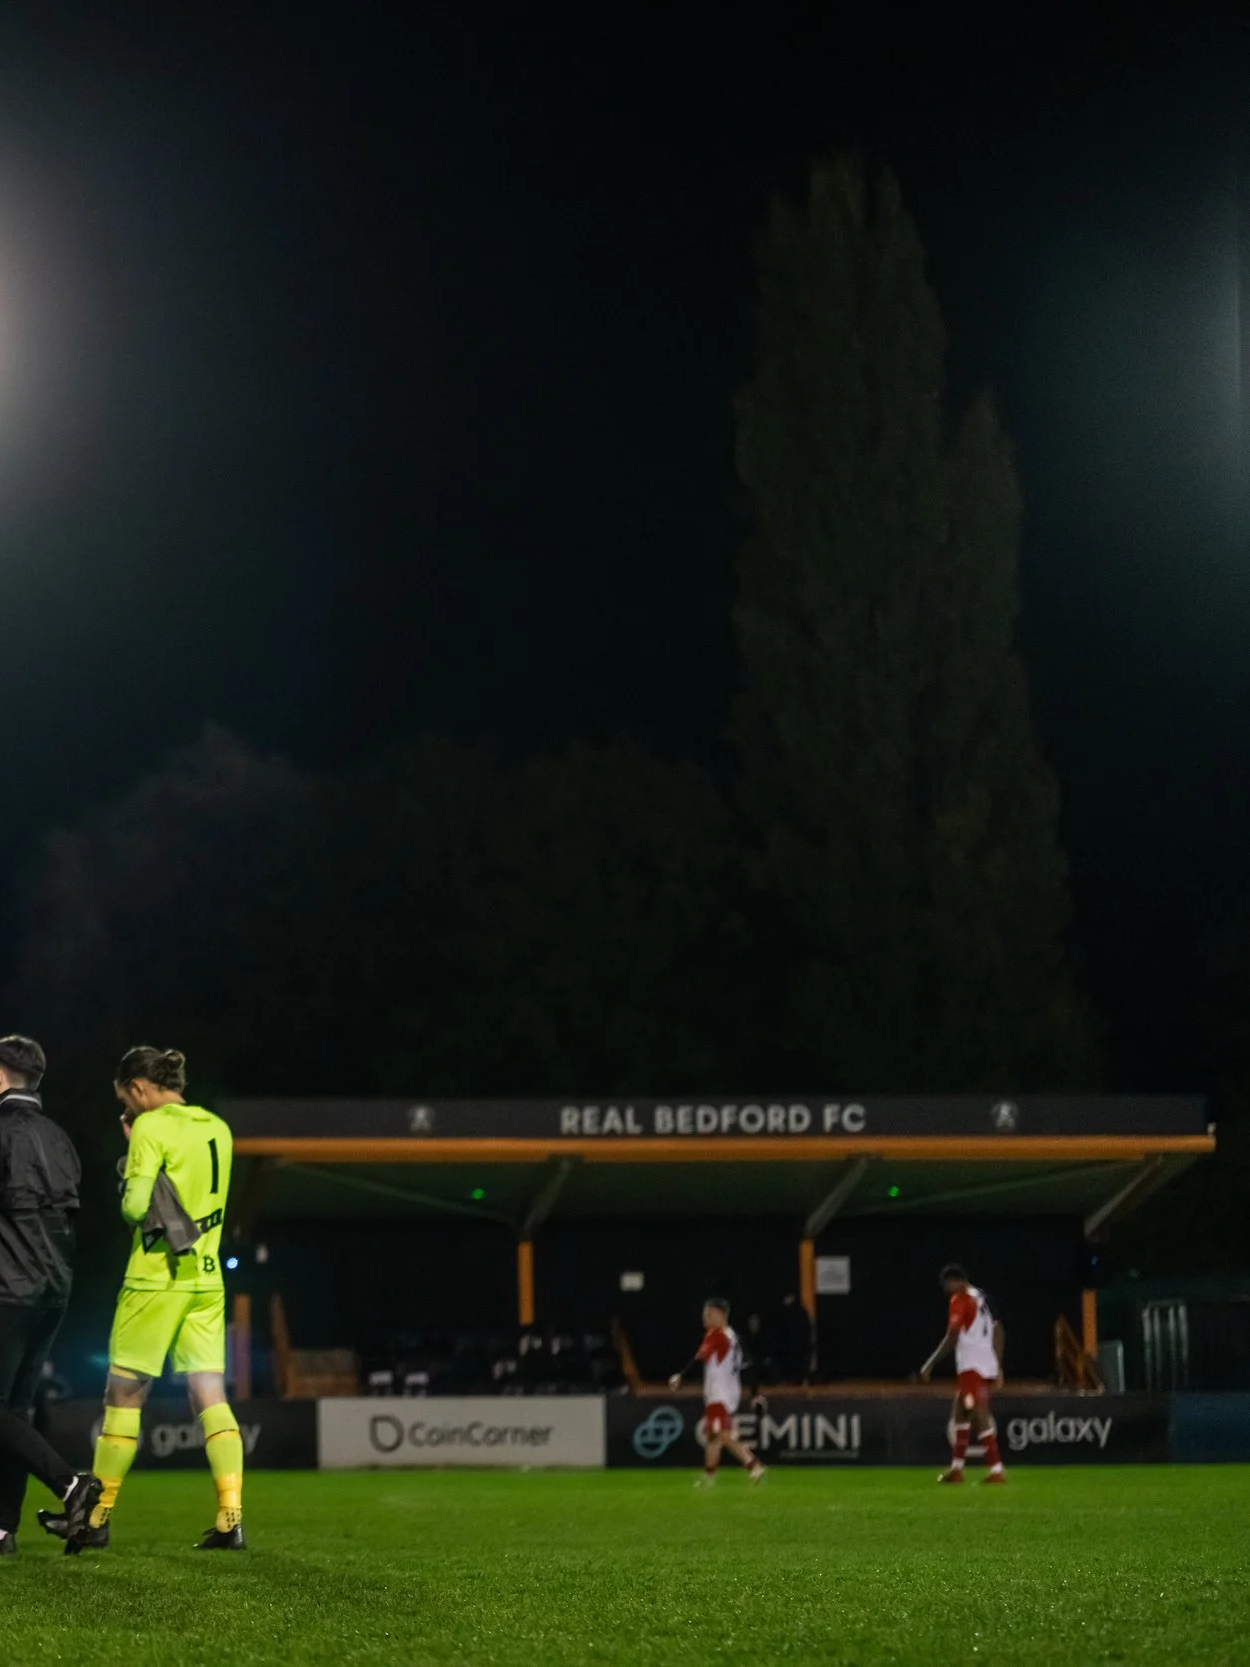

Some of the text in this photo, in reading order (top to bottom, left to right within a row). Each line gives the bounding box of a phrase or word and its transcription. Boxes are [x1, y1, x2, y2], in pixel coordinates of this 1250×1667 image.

[560, 1103, 867, 1135] REAL BEDFORD FC
[208, 1138, 220, 1194] 1
[408, 1421, 554, 1448] CoinCorner
[1006, 1410, 1112, 1451] galaxy
